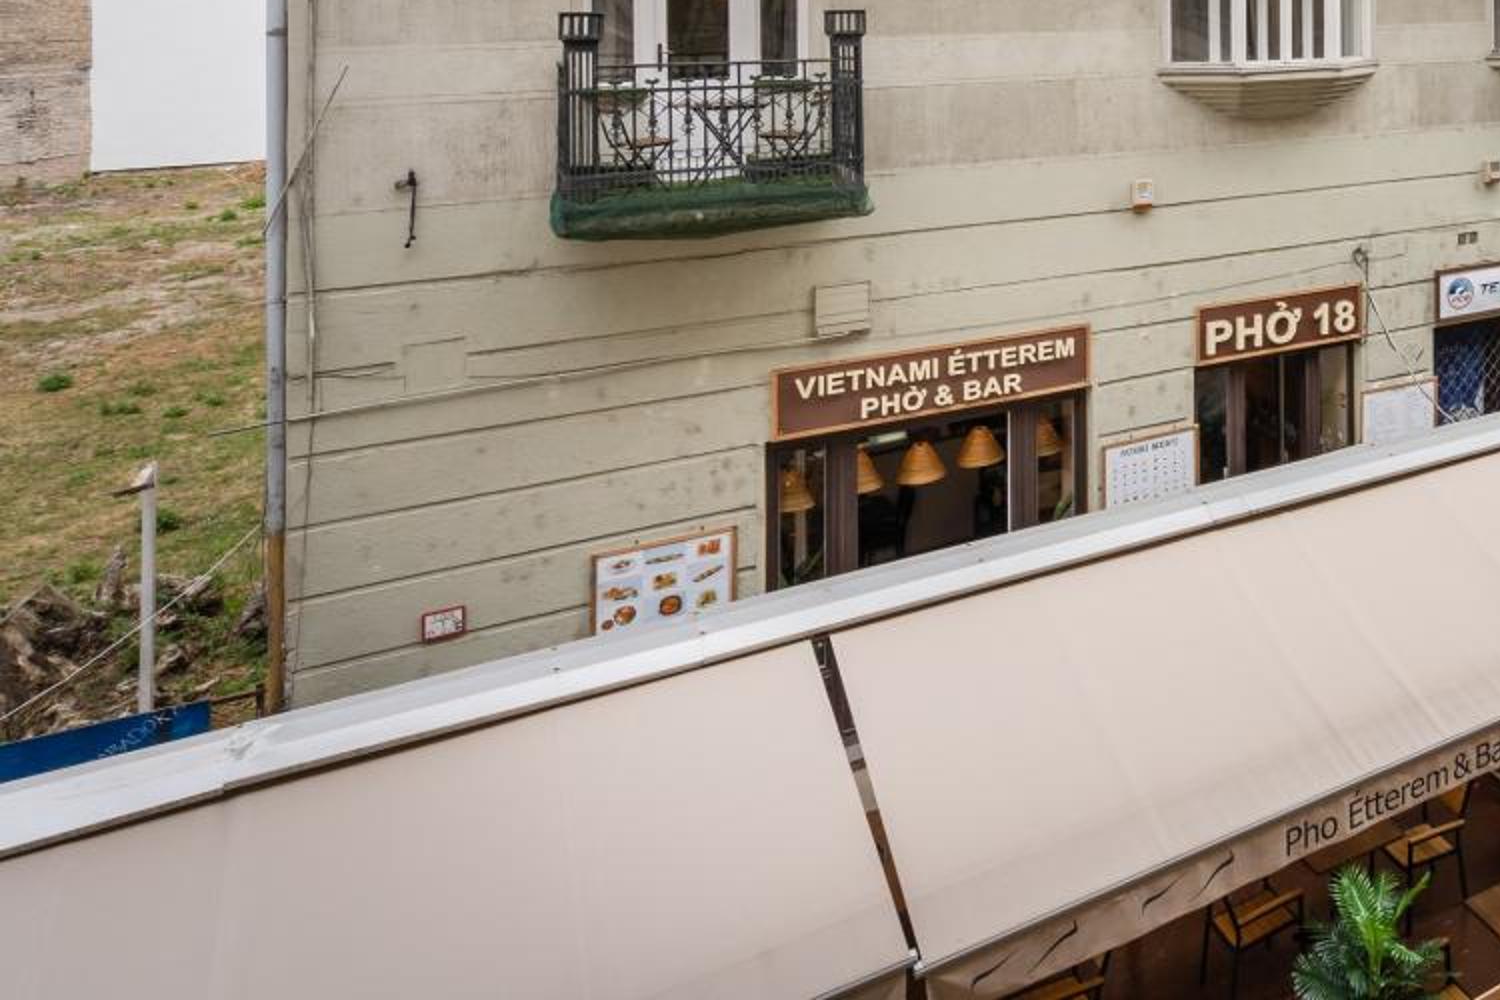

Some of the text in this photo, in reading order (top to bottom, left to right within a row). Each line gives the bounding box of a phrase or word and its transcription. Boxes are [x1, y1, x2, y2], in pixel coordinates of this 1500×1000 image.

[1205, 299, 1356, 356] PHỞ 18
[795, 337, 1076, 400] VIETNAMI ÉTTEREM
[934, 384, 954, 406] &
[963, 374, 1022, 401] BAR
[1286, 815, 1338, 857] Pho
[1349, 766, 1448, 830] Étterem
[1453, 752, 1470, 780] &
